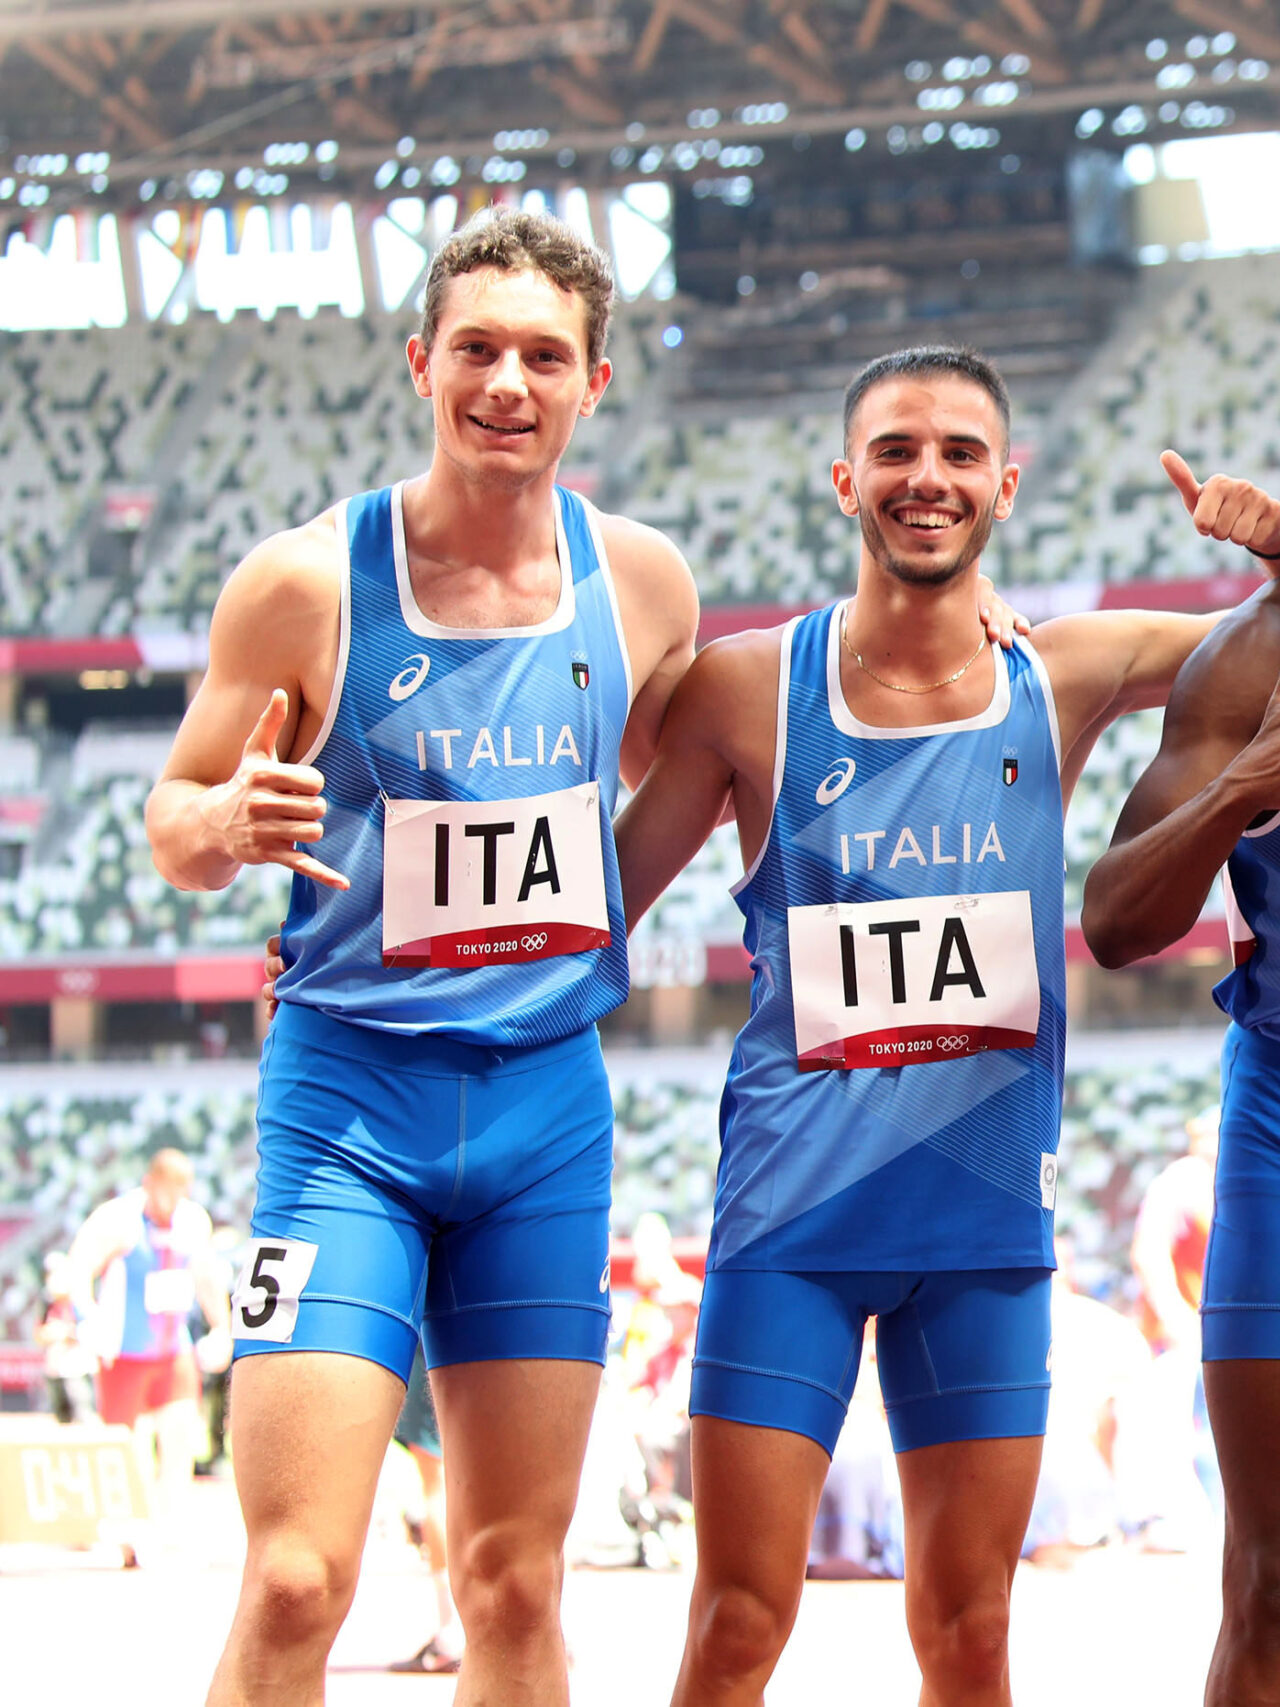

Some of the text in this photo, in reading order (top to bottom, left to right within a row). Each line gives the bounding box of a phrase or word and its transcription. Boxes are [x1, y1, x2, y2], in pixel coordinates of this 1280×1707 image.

[415, 724, 582, 771] ITALIA
[434, 815, 562, 907] ITA
[839, 821, 1006, 875] ITALIA
[456, 940, 518, 956] TOKYO 2020
[839, 916, 987, 1008] ITA
[868, 1039, 933, 1056] TOKYO 2020
[241, 1247, 288, 1329] 5
